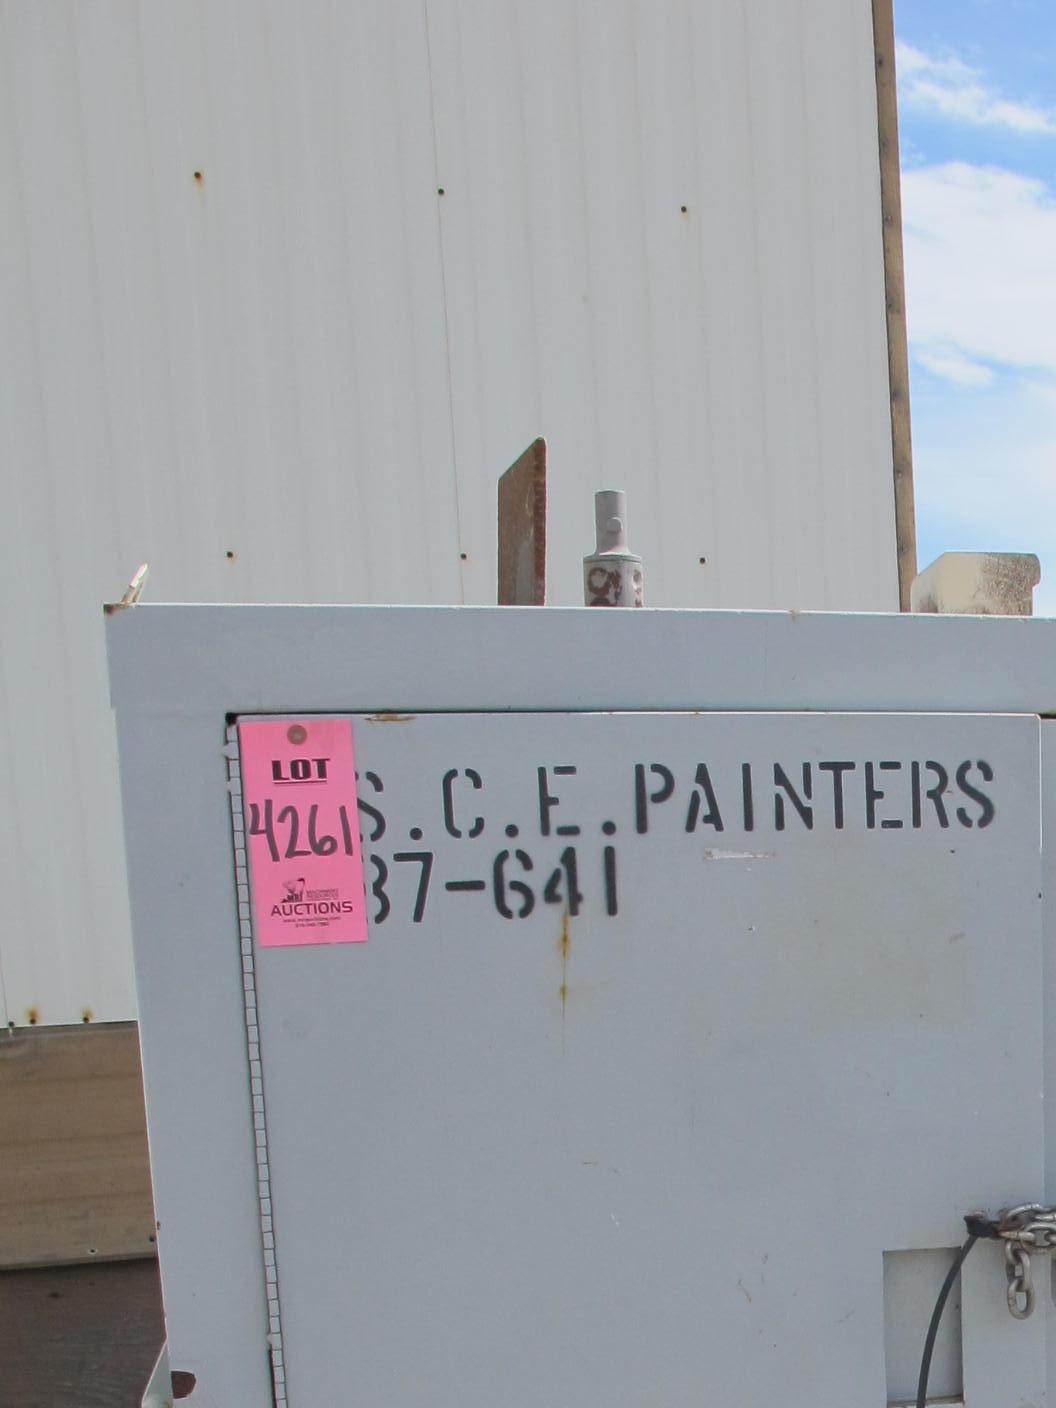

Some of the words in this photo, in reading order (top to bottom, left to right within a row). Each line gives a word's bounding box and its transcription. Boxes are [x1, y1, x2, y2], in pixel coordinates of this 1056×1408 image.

[271, 758, 330, 782] LOT
[634, 760, 996, 835] PAINTERS
[248, 799, 353, 862] 4261
[271, 901, 353, 917] AUCTIONS
